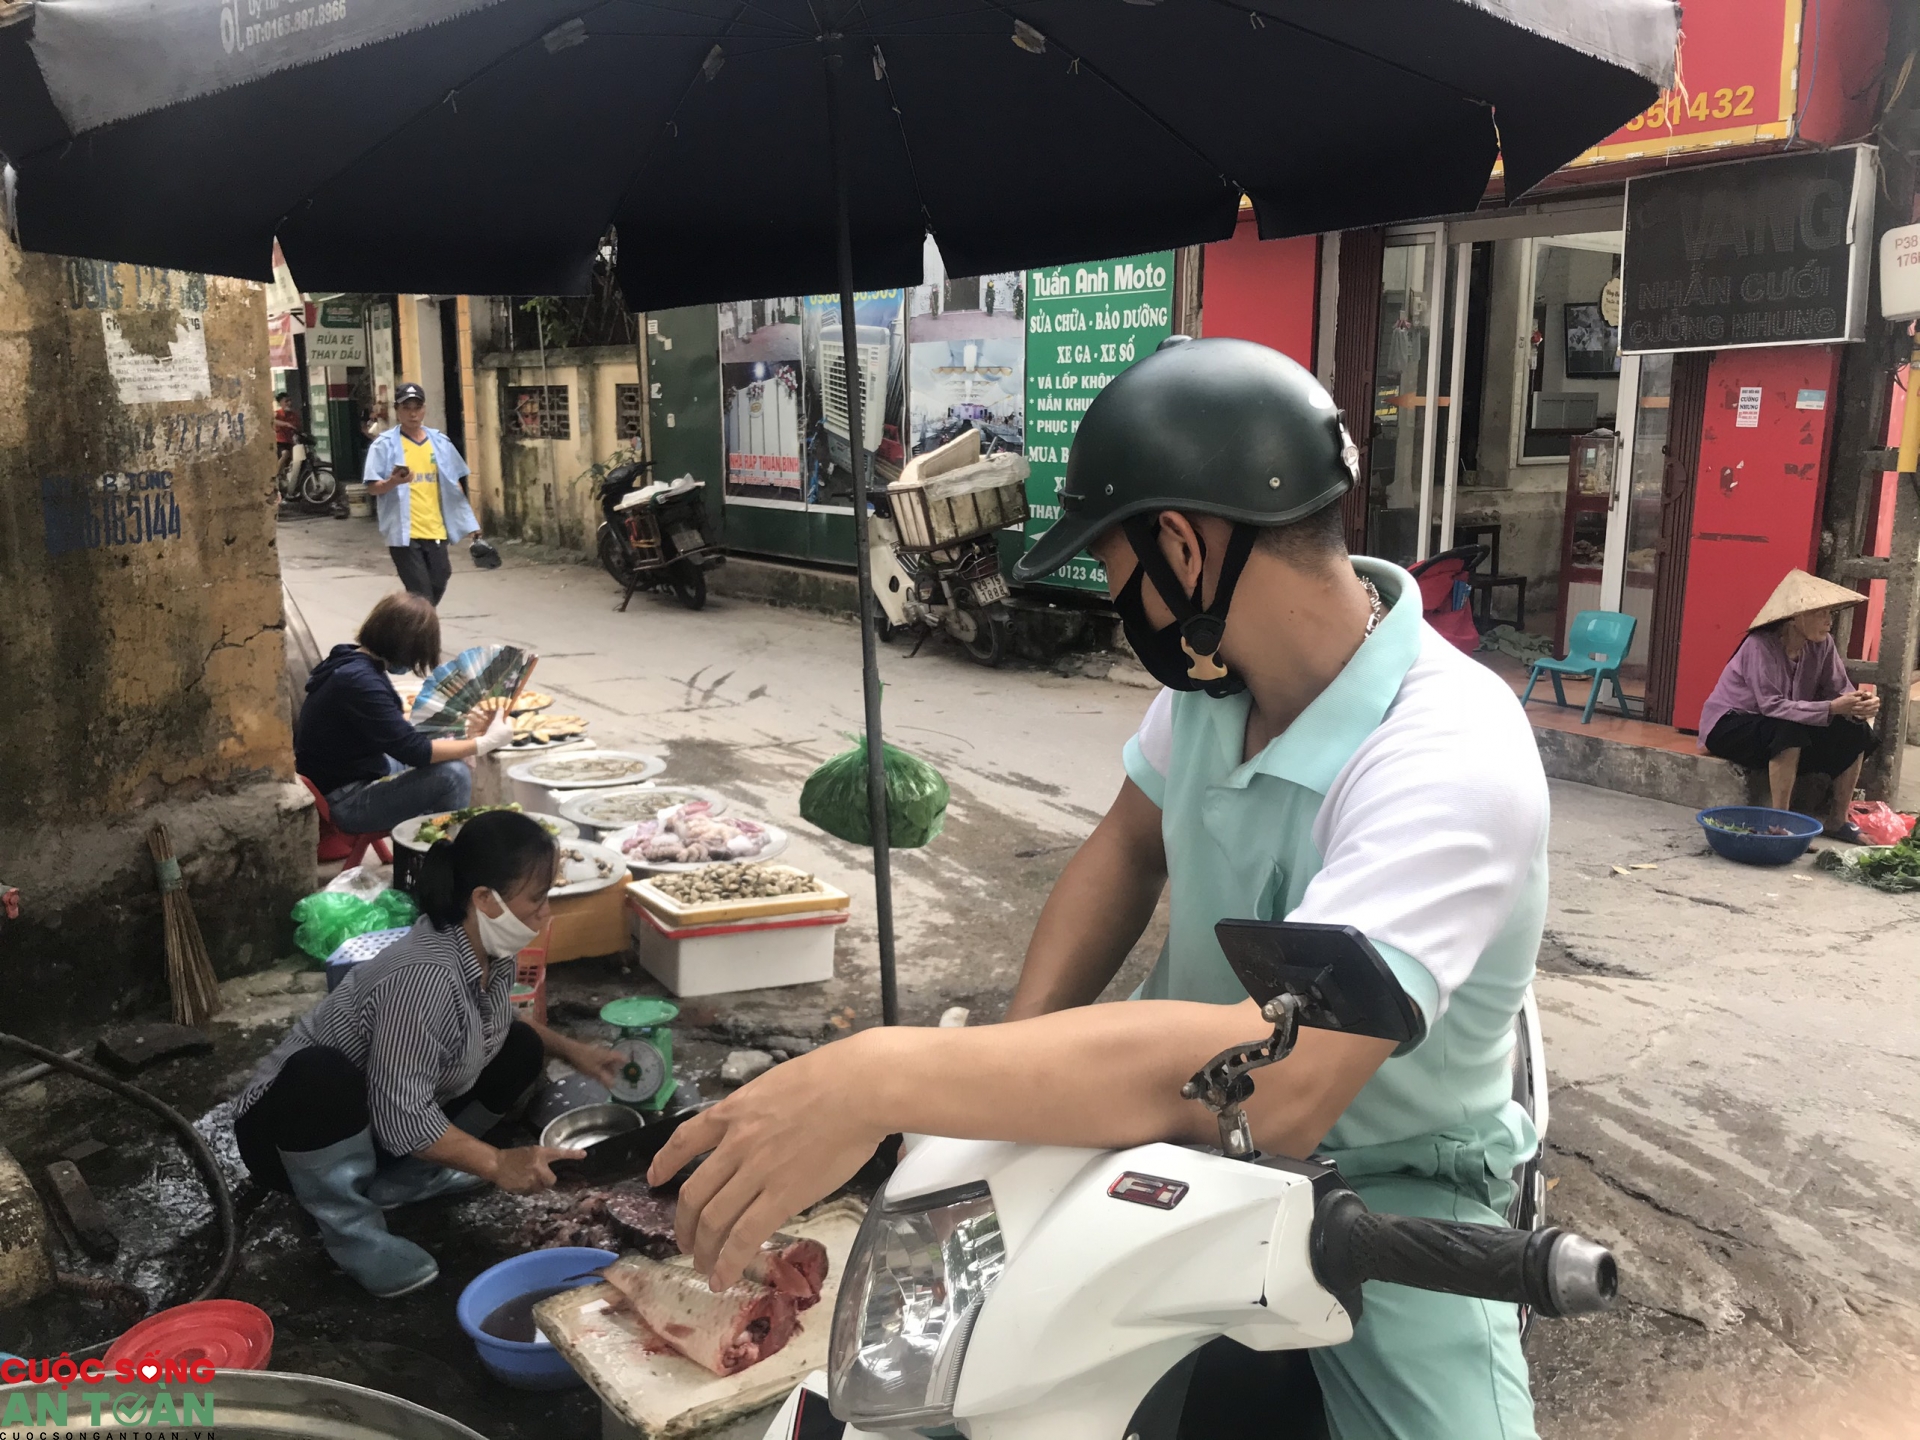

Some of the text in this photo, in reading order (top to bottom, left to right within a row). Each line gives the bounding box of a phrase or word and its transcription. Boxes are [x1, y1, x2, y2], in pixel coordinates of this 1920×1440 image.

[1897, 252, 1920, 267] 176
[1033, 263, 1166, 297] Tuấn Anh Moto
[1030, 303, 1167, 333] SỬA CHỮA BẢO DƯỠNG
[1732, 307, 1836, 338] NHUNG
[340, 334, 354, 345] XE
[311, 349, 338, 360] THAY
[1057, 334, 1135, 364] XE GA XE SỐ
[1037, 374, 1052, 390] VÁ
[1055, 371, 1078, 389] LỐP
[1065, 398, 1094, 412] KHU
[1036, 419, 1068, 435] PHỤC
[1028, 446, 1058, 463] MUA
[1029, 504, 1060, 520] THAY
[1058, 565, 1087, 580] 0123
